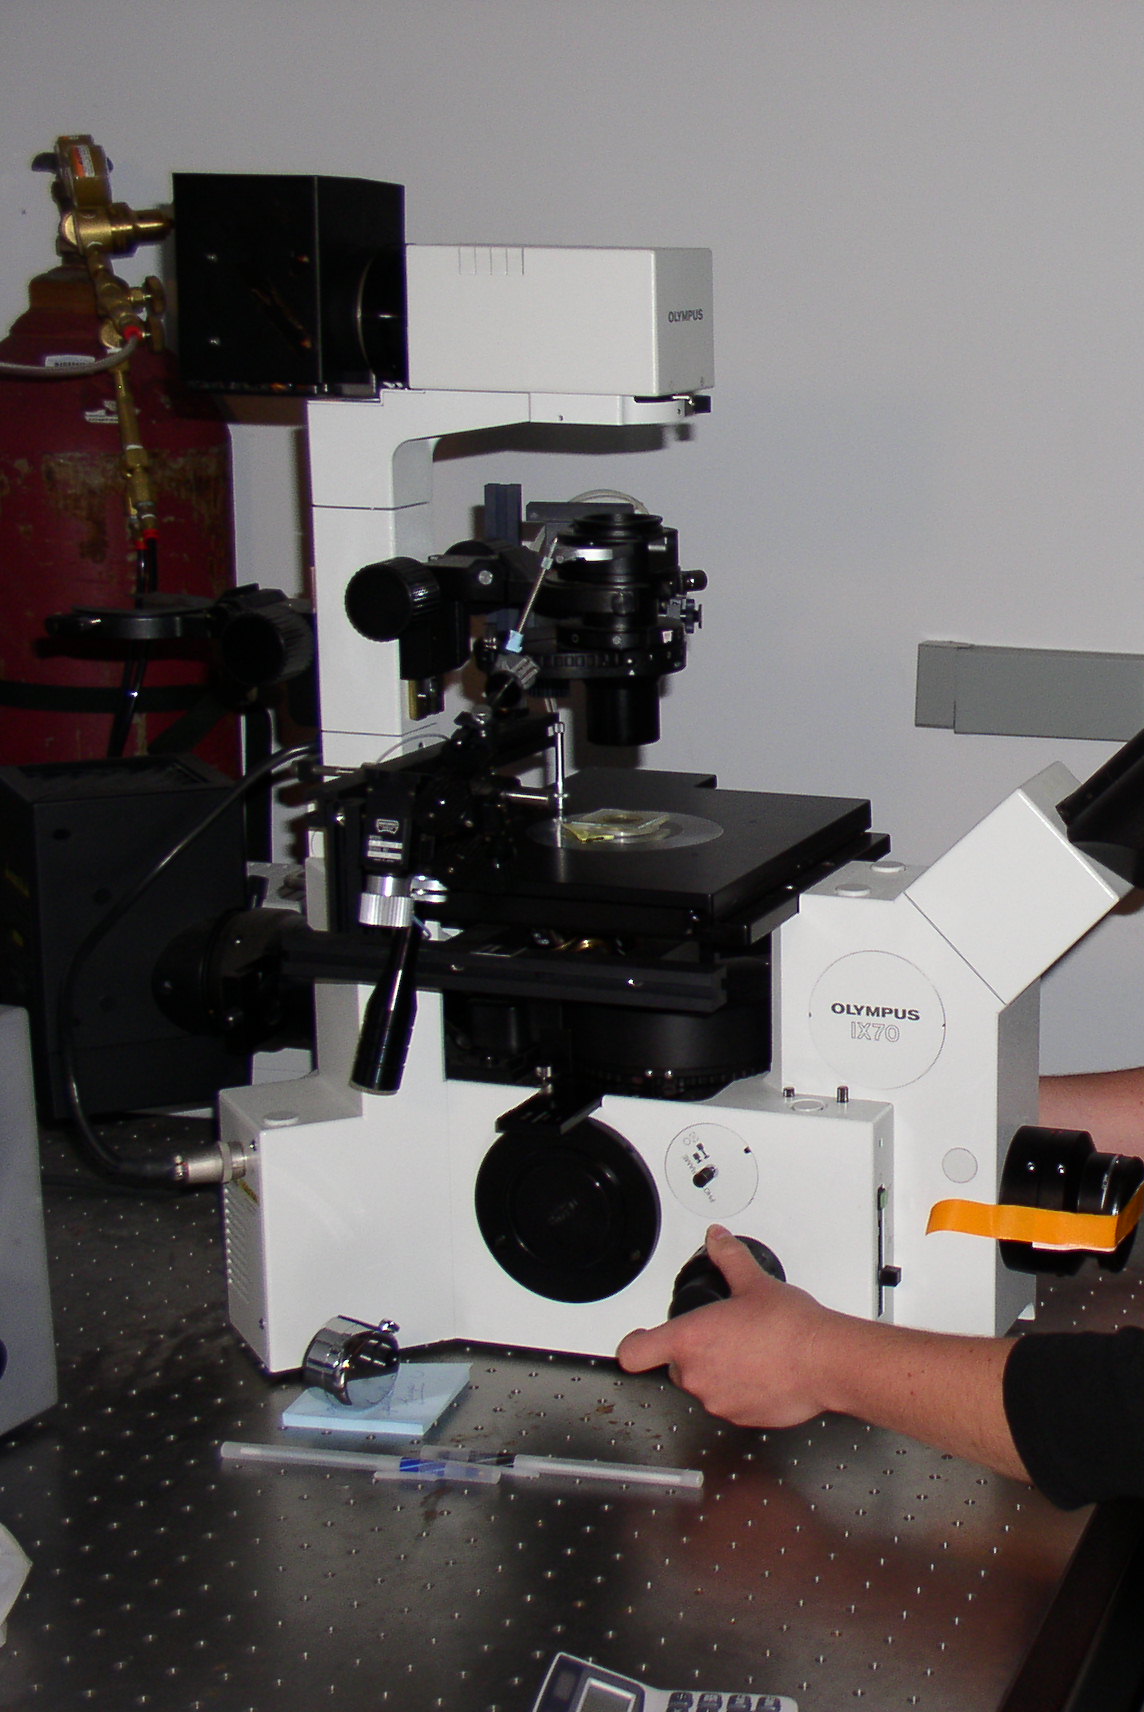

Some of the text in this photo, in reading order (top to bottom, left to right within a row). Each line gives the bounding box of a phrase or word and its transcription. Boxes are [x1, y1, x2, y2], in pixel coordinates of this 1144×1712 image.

[668, 308, 704, 323] OLYMPUS
[831, 1002, 921, 1022] OLYMPUS
[850, 1020, 901, 1043] IX70
